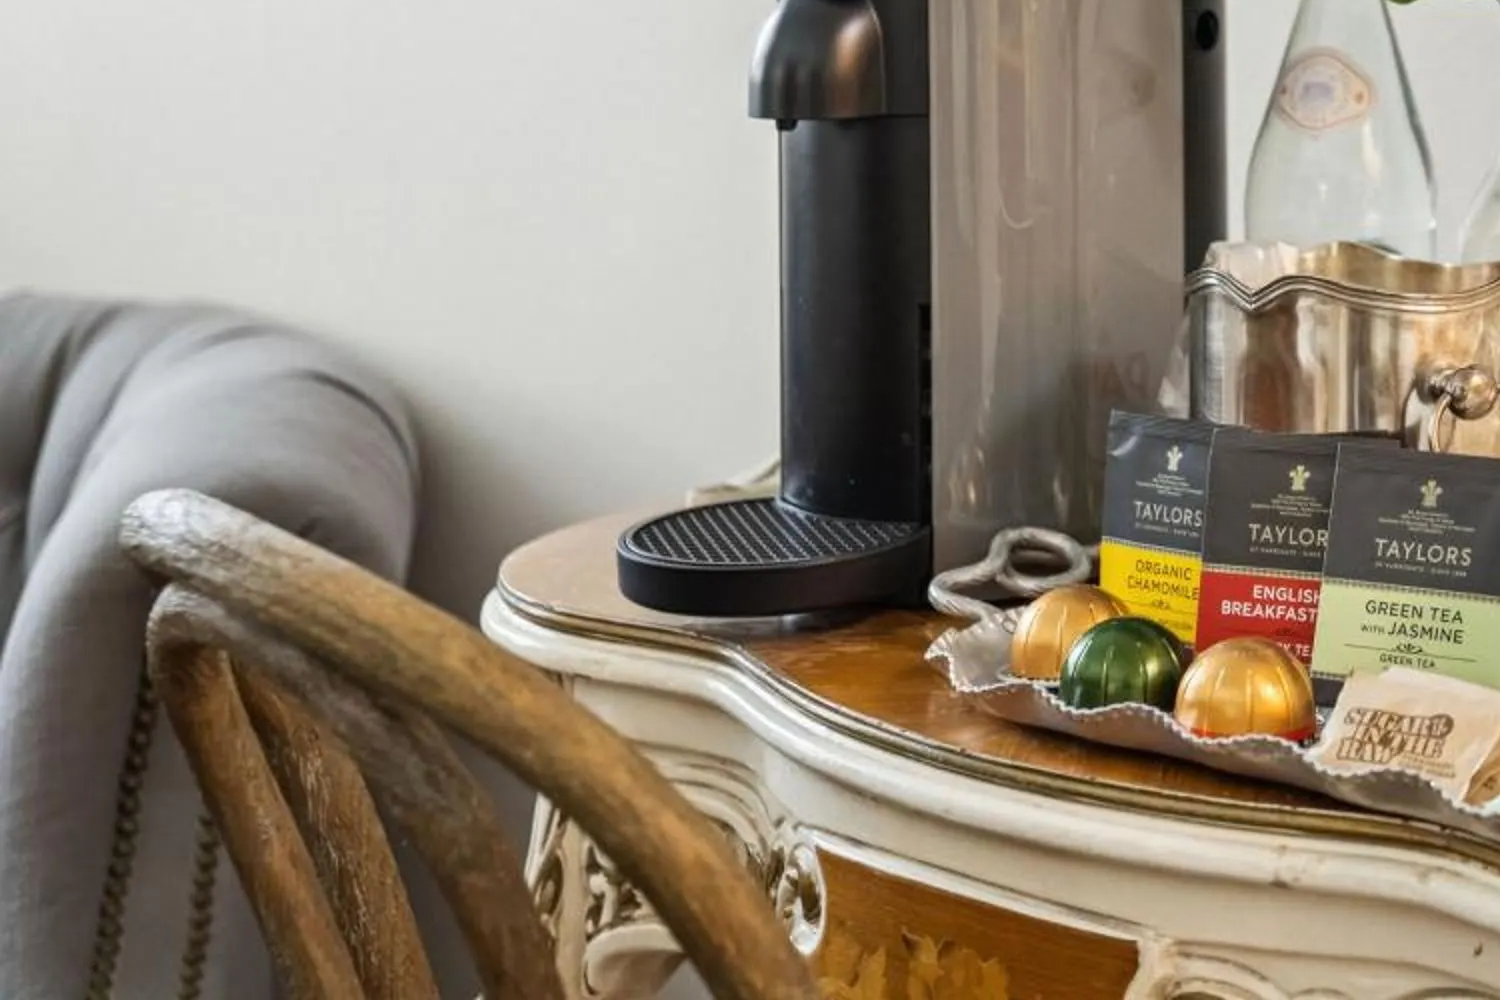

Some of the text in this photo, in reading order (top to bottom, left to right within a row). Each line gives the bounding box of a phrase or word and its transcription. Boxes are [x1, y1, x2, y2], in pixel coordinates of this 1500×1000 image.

[1134, 500, 1203, 527] TAYLORS
[1248, 523, 1328, 547] TAYLOR
[1375, 538, 1472, 567] TAYLORS
[1135, 560, 1193, 581] ORGANIC
[1127, 575, 1200, 601] CHAMOMILE
[1221, 599, 1318, 623] BREAKFAST
[1365, 599, 1463, 624] GREEN TEA
[1388, 621, 1465, 645] JASMINE
[1379, 652, 1436, 669] GREEN TEA
